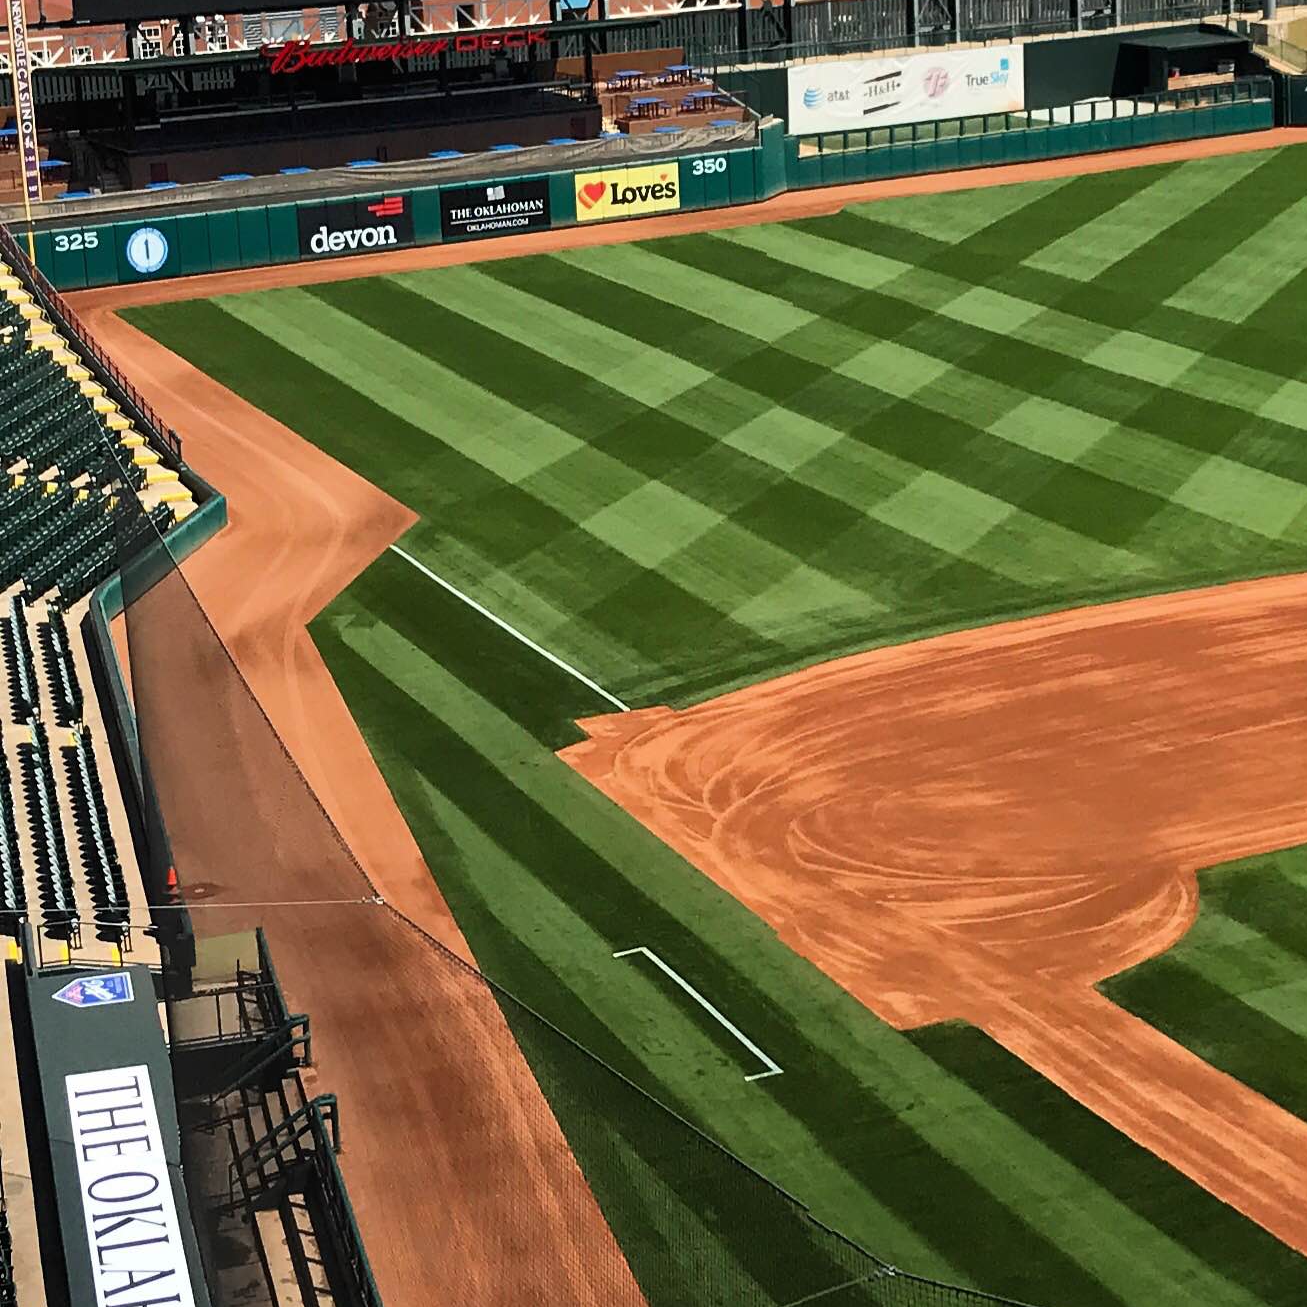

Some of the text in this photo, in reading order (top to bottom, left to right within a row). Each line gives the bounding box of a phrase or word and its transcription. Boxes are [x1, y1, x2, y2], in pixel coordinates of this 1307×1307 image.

[12, 0, 28, 68] NEWCASTLE
[260, 28, 549, 75] Budweiser DECK
[18, 70, 34, 134] CASINO
[827, 89, 850, 102] at&t
[692, 157, 727, 176] 350
[450, 199, 544, 221] THE OKLAHOMAN
[54, 231, 99, 252] 325
[310, 223, 398, 255] devon
[74, 1074, 154, 1166] THE
